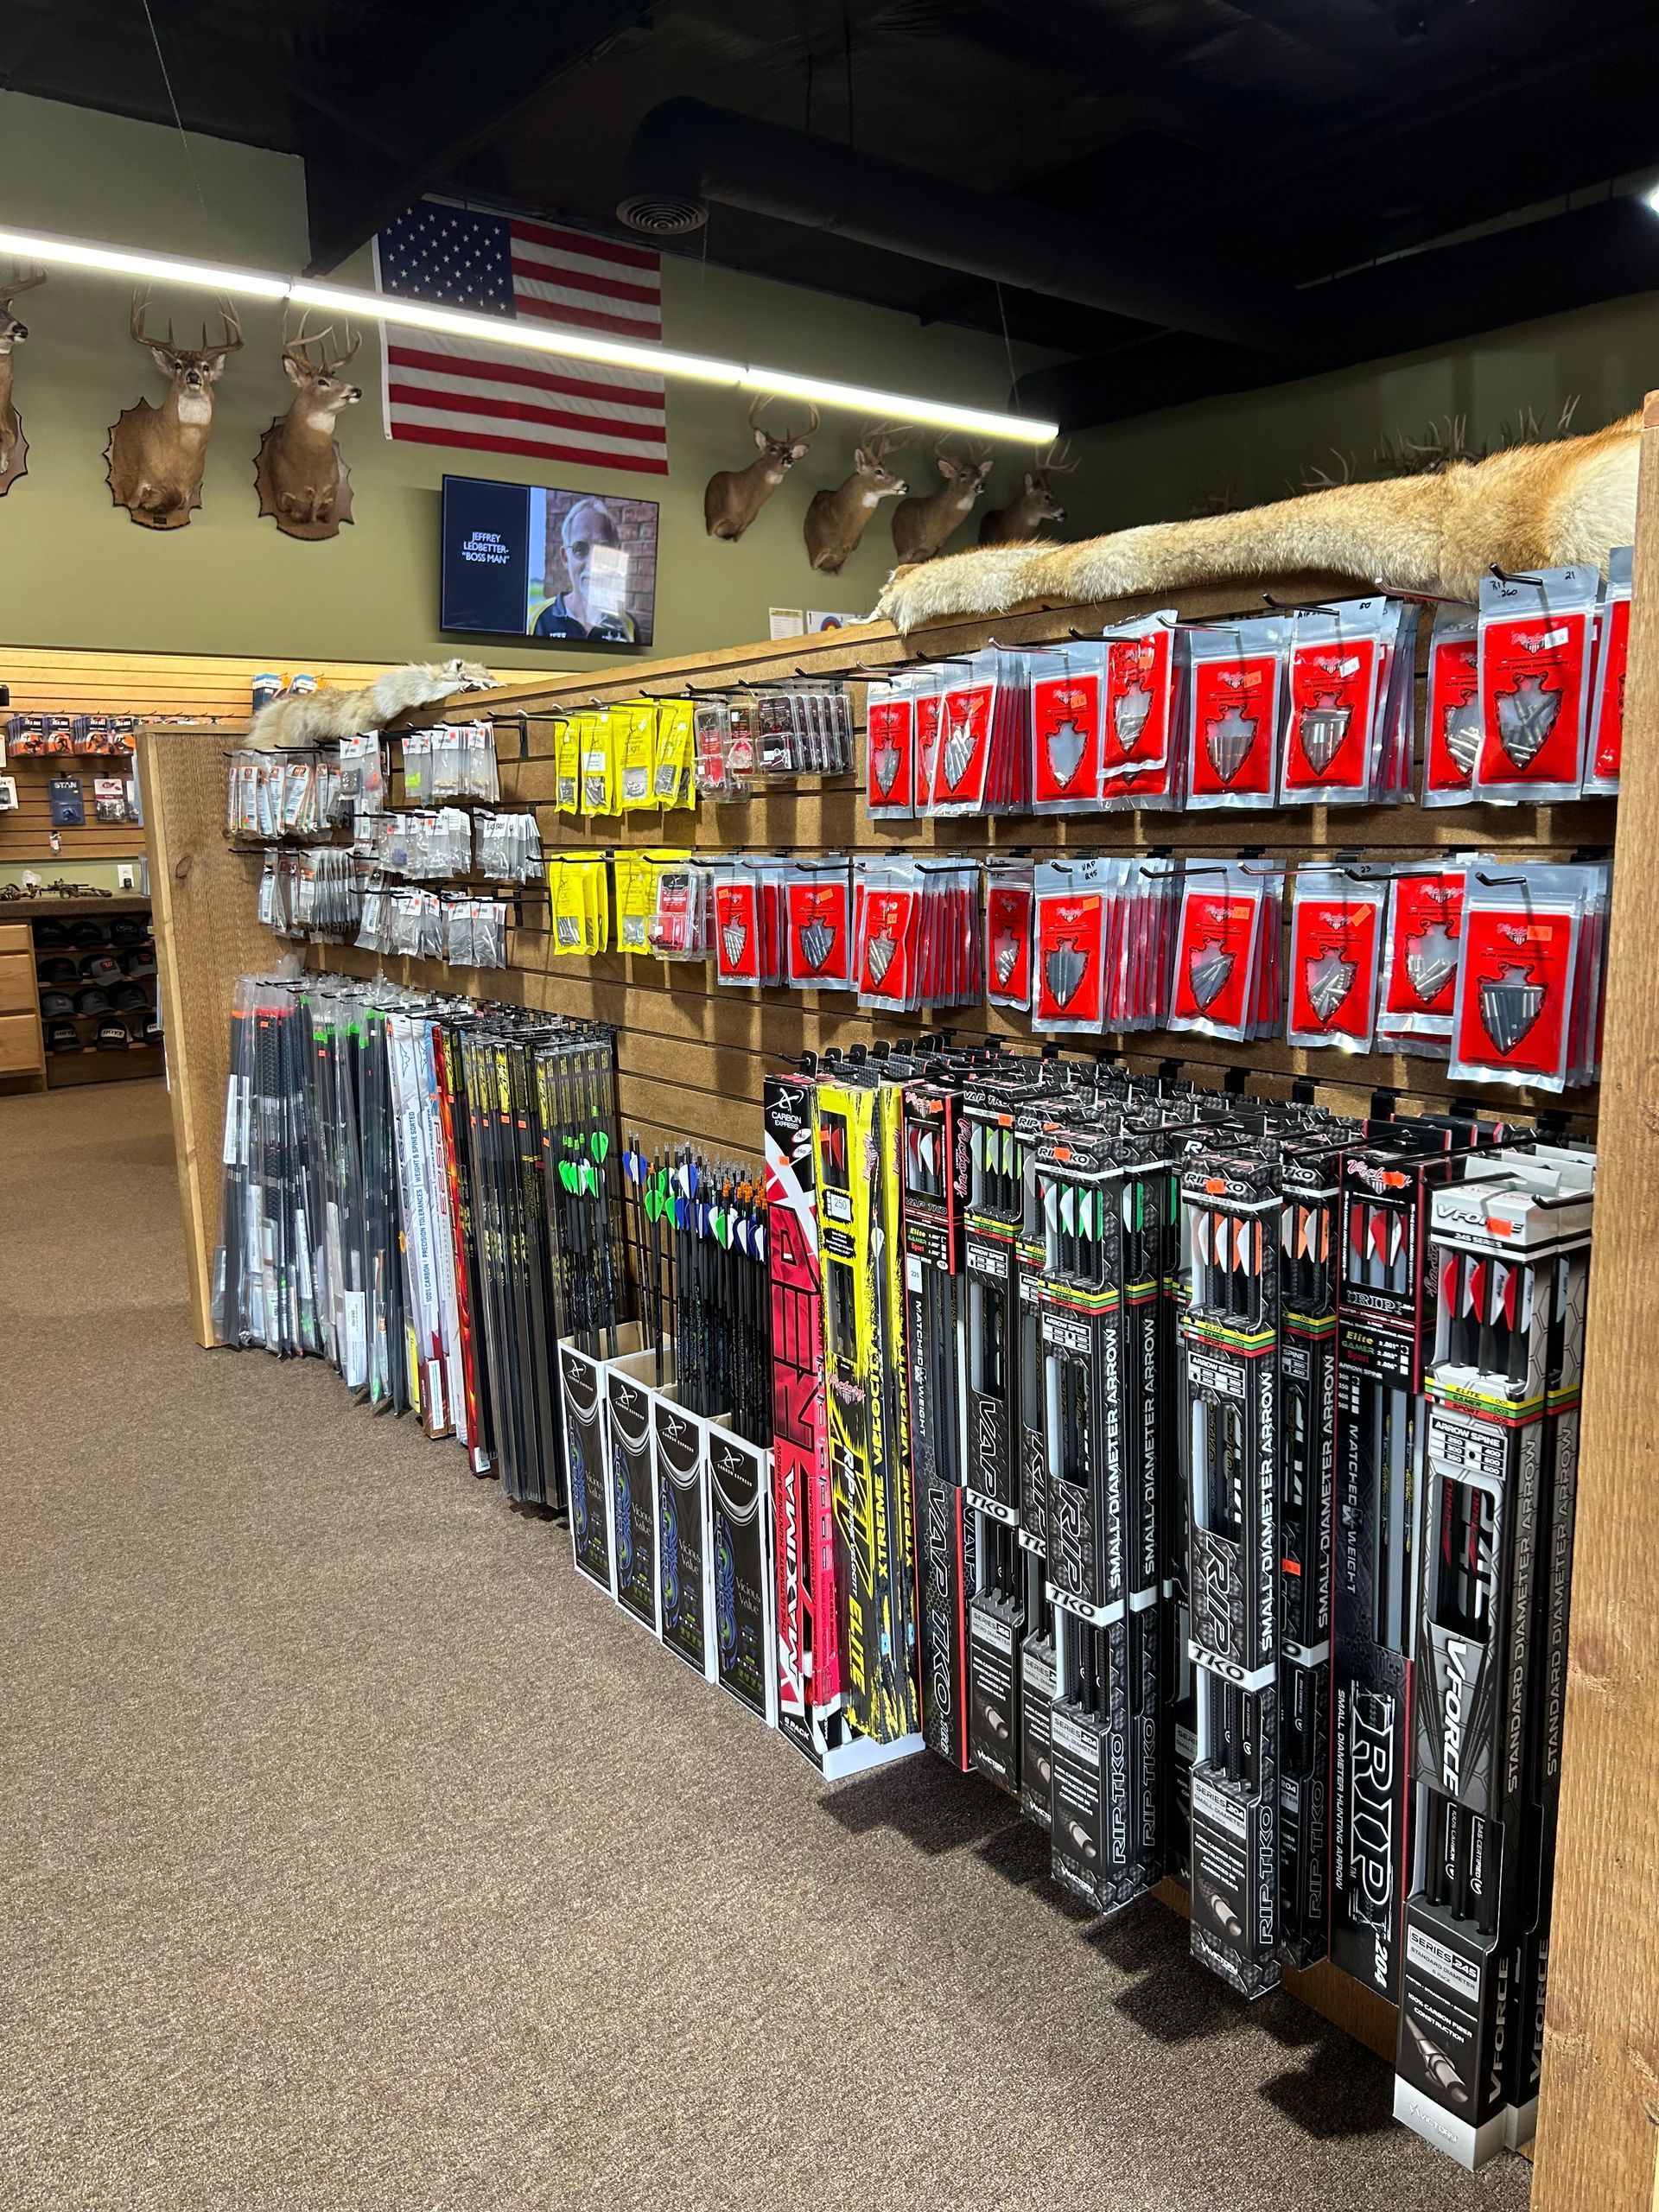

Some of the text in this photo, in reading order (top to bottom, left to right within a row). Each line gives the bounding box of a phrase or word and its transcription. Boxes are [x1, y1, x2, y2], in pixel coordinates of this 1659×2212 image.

[463, 542, 510, 554] LEDBETTER-
[472, 531, 501, 543] JEFFREY
[1564, 571, 1575, 580] 21
[54, 781, 78, 790] STAN
[963, 1090, 985, 1103] VAP
[772, 1111, 802, 1124] CARBON
[775, 1120, 800, 1130] EXPRESS
[1283, 1167, 1314, 1179] TKO
[834, 1198, 847, 1210] 250
[419, 1227, 428, 1258] PRECISION
[910, 1228, 926, 1237] Elite
[1471, 1236, 1503, 1249] SERIES
[911, 1243, 925, 1252] Sport
[969, 1247, 1005, 1262] ARROW SPINE
[423, 1263, 432, 1288] CARBON
[1046, 1318, 1087, 1335] ARROW SPINE
[1204, 1332, 1225, 1340] GAMER
[1205, 1324, 1224, 1332] ELITE
[1345, 1331, 1374, 1344] Elite
[1283, 1349, 1305, 1360] SPINE
[1341, 1340, 1375, 1355] GAMER
[1346, 1351, 1370, 1363] Sport
[914, 1300, 925, 1437] MATCHED WEIGHT
[1192, 1357, 1241, 1377] ARROW SPINE
[1339, 1363, 1382, 1380] ARROW SPINE
[1452, 1395, 1482, 1408] GAMER
[1456, 1387, 1482, 1399] ELITE
[615, 1400, 629, 1412] CARBON
[1452, 1403, 1480, 1414] SPORT
[662, 1431, 677, 1443] CARBON
[1435, 1421, 1501, 1447] ARROW SPINE
[979, 1401, 996, 1497] VAP
[1105, 1328, 1121, 1589] SMALL DIAMETER ARROW
[1144, 1319, 1155, 1575] SMALL DIAMETER ARROW
[1446, 1446, 1501, 1466] 300 500
[1484, 1449, 1501, 1458] 400
[717, 1463, 734, 1477] CARBON
[775, 1441, 784, 1490] ARROW
[1446, 1454, 1500, 1475] 350 600
[585, 1470, 604, 1491] Vicious
[734, 1472, 753, 1487] EXPRESS
[587, 1484, 603, 1502] Value
[1319, 1355, 1335, 1630] SMALL DIAMETER ARROW
[632, 1502, 654, 1525] Vicious
[902, 1464, 916, 1567] XTREME
[970, 1493, 1008, 1520] TKO
[1262, 1372, 1273, 1652] SMALL DIAMETER ARROW
[1347, 1424, 1359, 1594] MATCHED WEIGHT
[633, 1516, 652, 1537] Value
[776, 1492, 785, 1548] HUNTING
[842, 1446, 858, 1597] RIP VELOCITY
[874, 1473, 888, 1580] XTREME
[1060, 1482, 1082, 1595] RIP
[678, 1538, 702, 1563] Vicious
[680, 1553, 700, 1576] Value
[784, 1466, 801, 1681] MAXIMA
[735, 1575, 761, 1603] Vicious
[1206, 1535, 1230, 1655] RIP
[738, 1592, 760, 1616] Value
[927, 1488, 951, 1720] VAP TKO
[1051, 1586, 1096, 1619] TKO
[1547, 1427, 1572, 1777] STANDARD DIAMETER ARROW
[974, 1612, 996, 1630] SERIES
[1508, 1440, 1535, 1794] STANDARD DIAMETER ARROW
[849, 1595, 866, 1695] ELITE
[1025, 1658, 1049, 1678] SERIES
[1194, 1645, 1245, 1681] TKO
[1054, 1718, 1081, 1738] SERIES
[1443, 1638, 1466, 1796] VFORCE
[791, 1721, 810, 1741] PACK
[1054, 1728, 1098, 1758] SMALL DIAMETER
[1142, 1718, 1156, 1847] RIP TKO
[1111, 1733, 1126, 1864] RIP TKO
[1197, 1784, 1226, 1808] SERIES
[1194, 1794, 1246, 1830] SMALL DIAMETER
[1194, 1841, 1231, 1869] CONSTRUCTION
[1208, 1839, 1229, 1859] CARBON
[1309, 1780, 1325, 1918] RIP TKO
[1352, 1707, 1393, 1988] RIP .204
[1200, 1862, 1221, 1880] CARBON
[1203, 1855, 1228, 1877] ADVANCED
[1259, 1805, 1274, 1944] RIP TKO
[1411, 1932, 1452, 1963] SERIES
[1410, 1947, 1475, 1990] STANDARD DIAMETER
[1437, 1972, 1451, 1984] PACK
[1408, 1992, 1473, 2038] 100% CARBON FIBER
[1414, 2007, 1465, 2044] CONSTRUCTION
[1488, 1957, 1508, 2105] VFORCE
[1420, 2112, 1459, 2143] VICTORY
